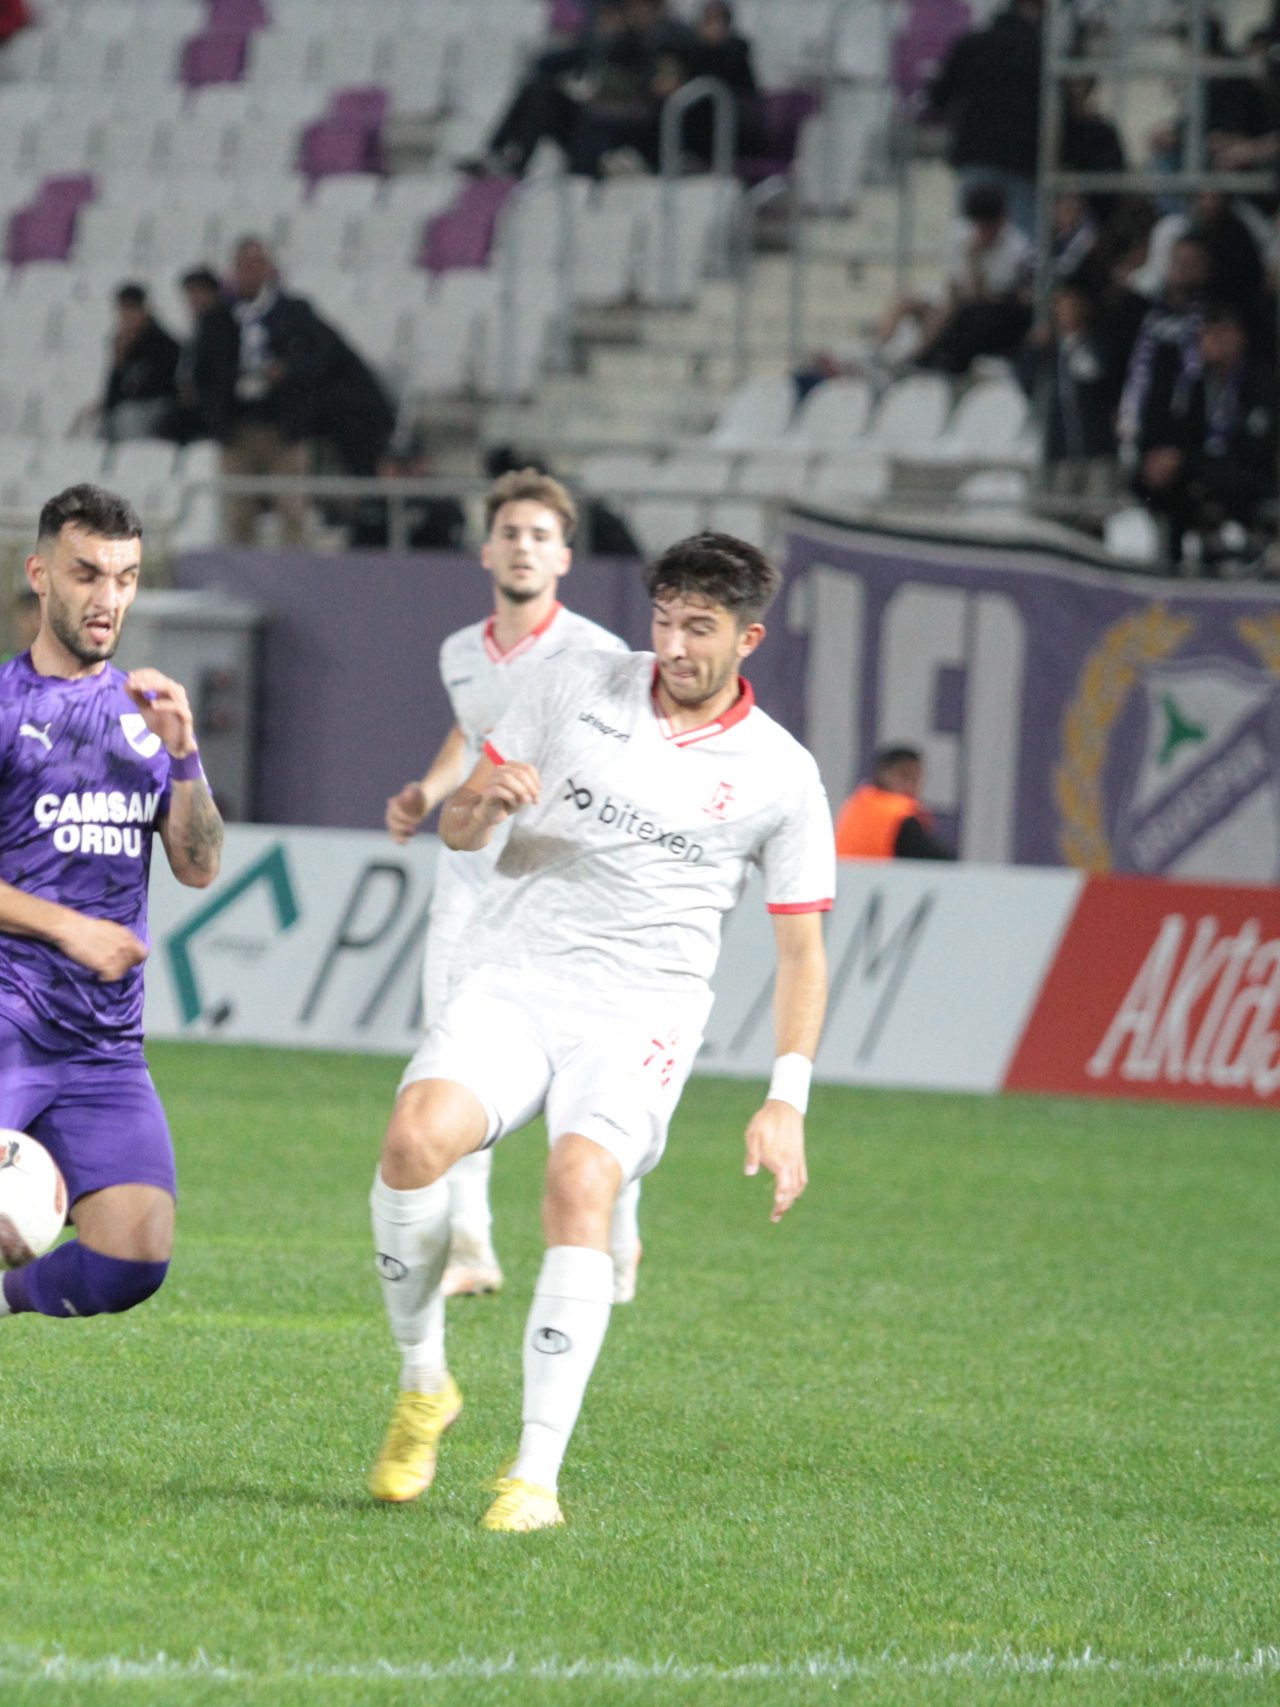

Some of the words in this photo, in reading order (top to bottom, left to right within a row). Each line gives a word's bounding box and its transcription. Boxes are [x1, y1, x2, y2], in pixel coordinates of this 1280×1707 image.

[33, 789, 159, 829] ÇAMSAN
[597, 796, 705, 864] bitexen
[52, 823, 142, 858] ORDU
[1085, 913, 1280, 1096] Akta
